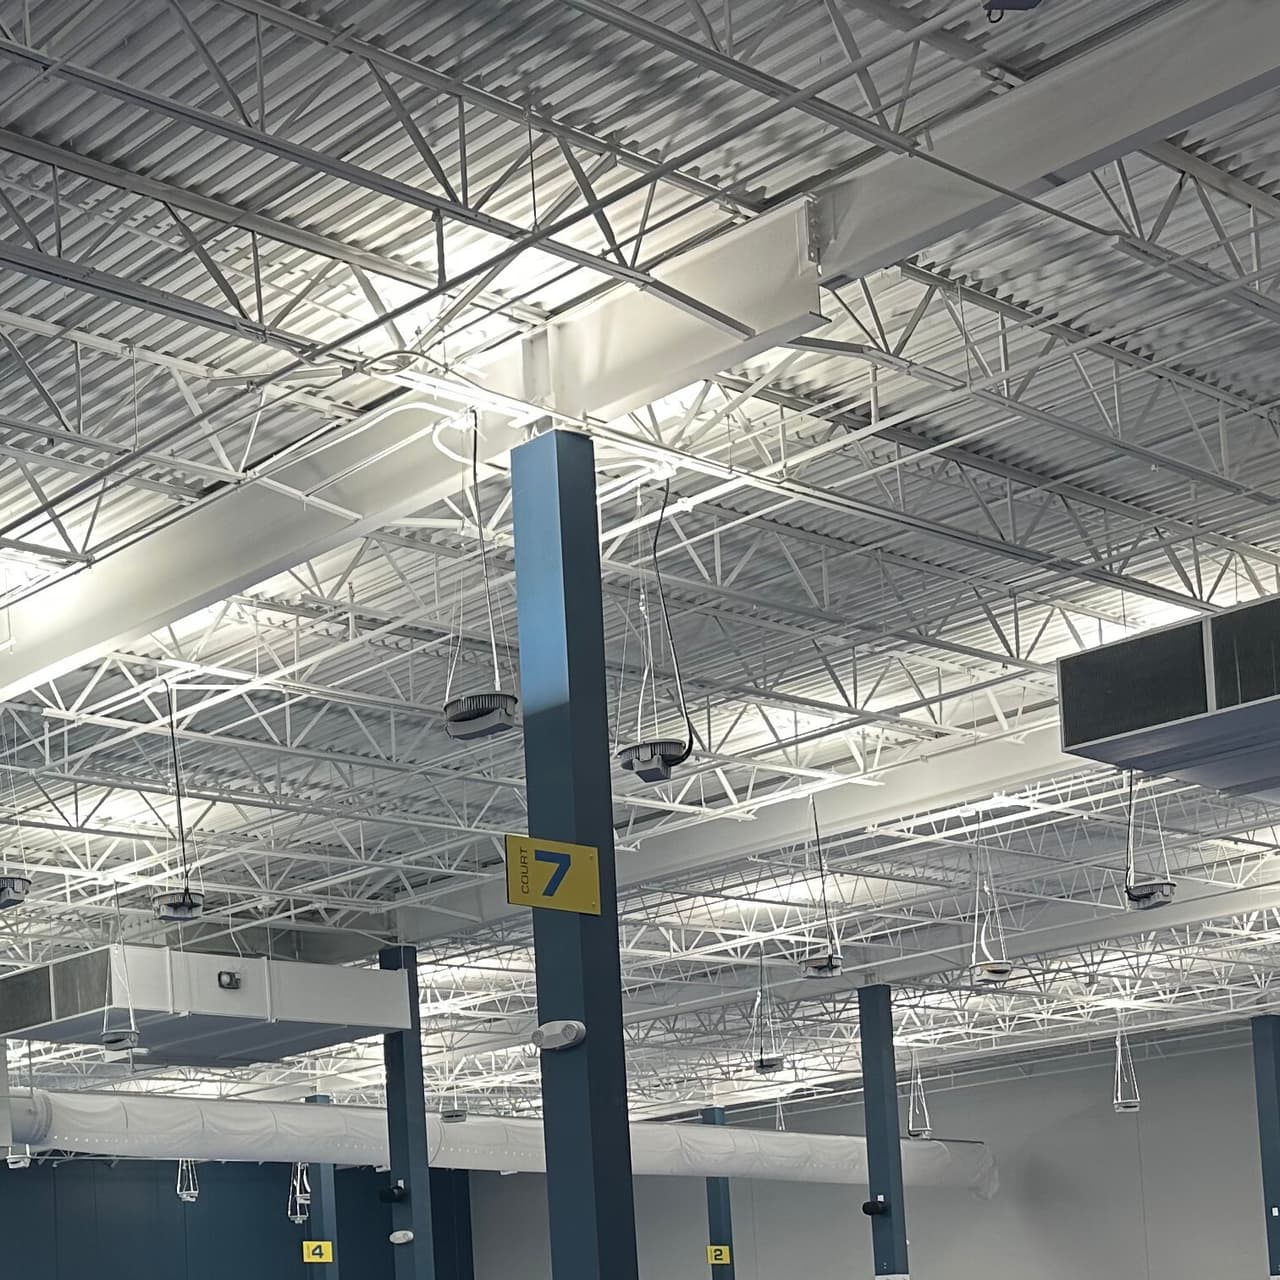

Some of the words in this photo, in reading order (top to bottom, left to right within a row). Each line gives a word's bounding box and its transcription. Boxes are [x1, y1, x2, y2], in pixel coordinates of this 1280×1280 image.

[520, 846, 530, 895] COURT
[534, 849, 571, 897] 7
[311, 1244, 324, 1258] 4
[713, 1248, 723, 1261] 2
